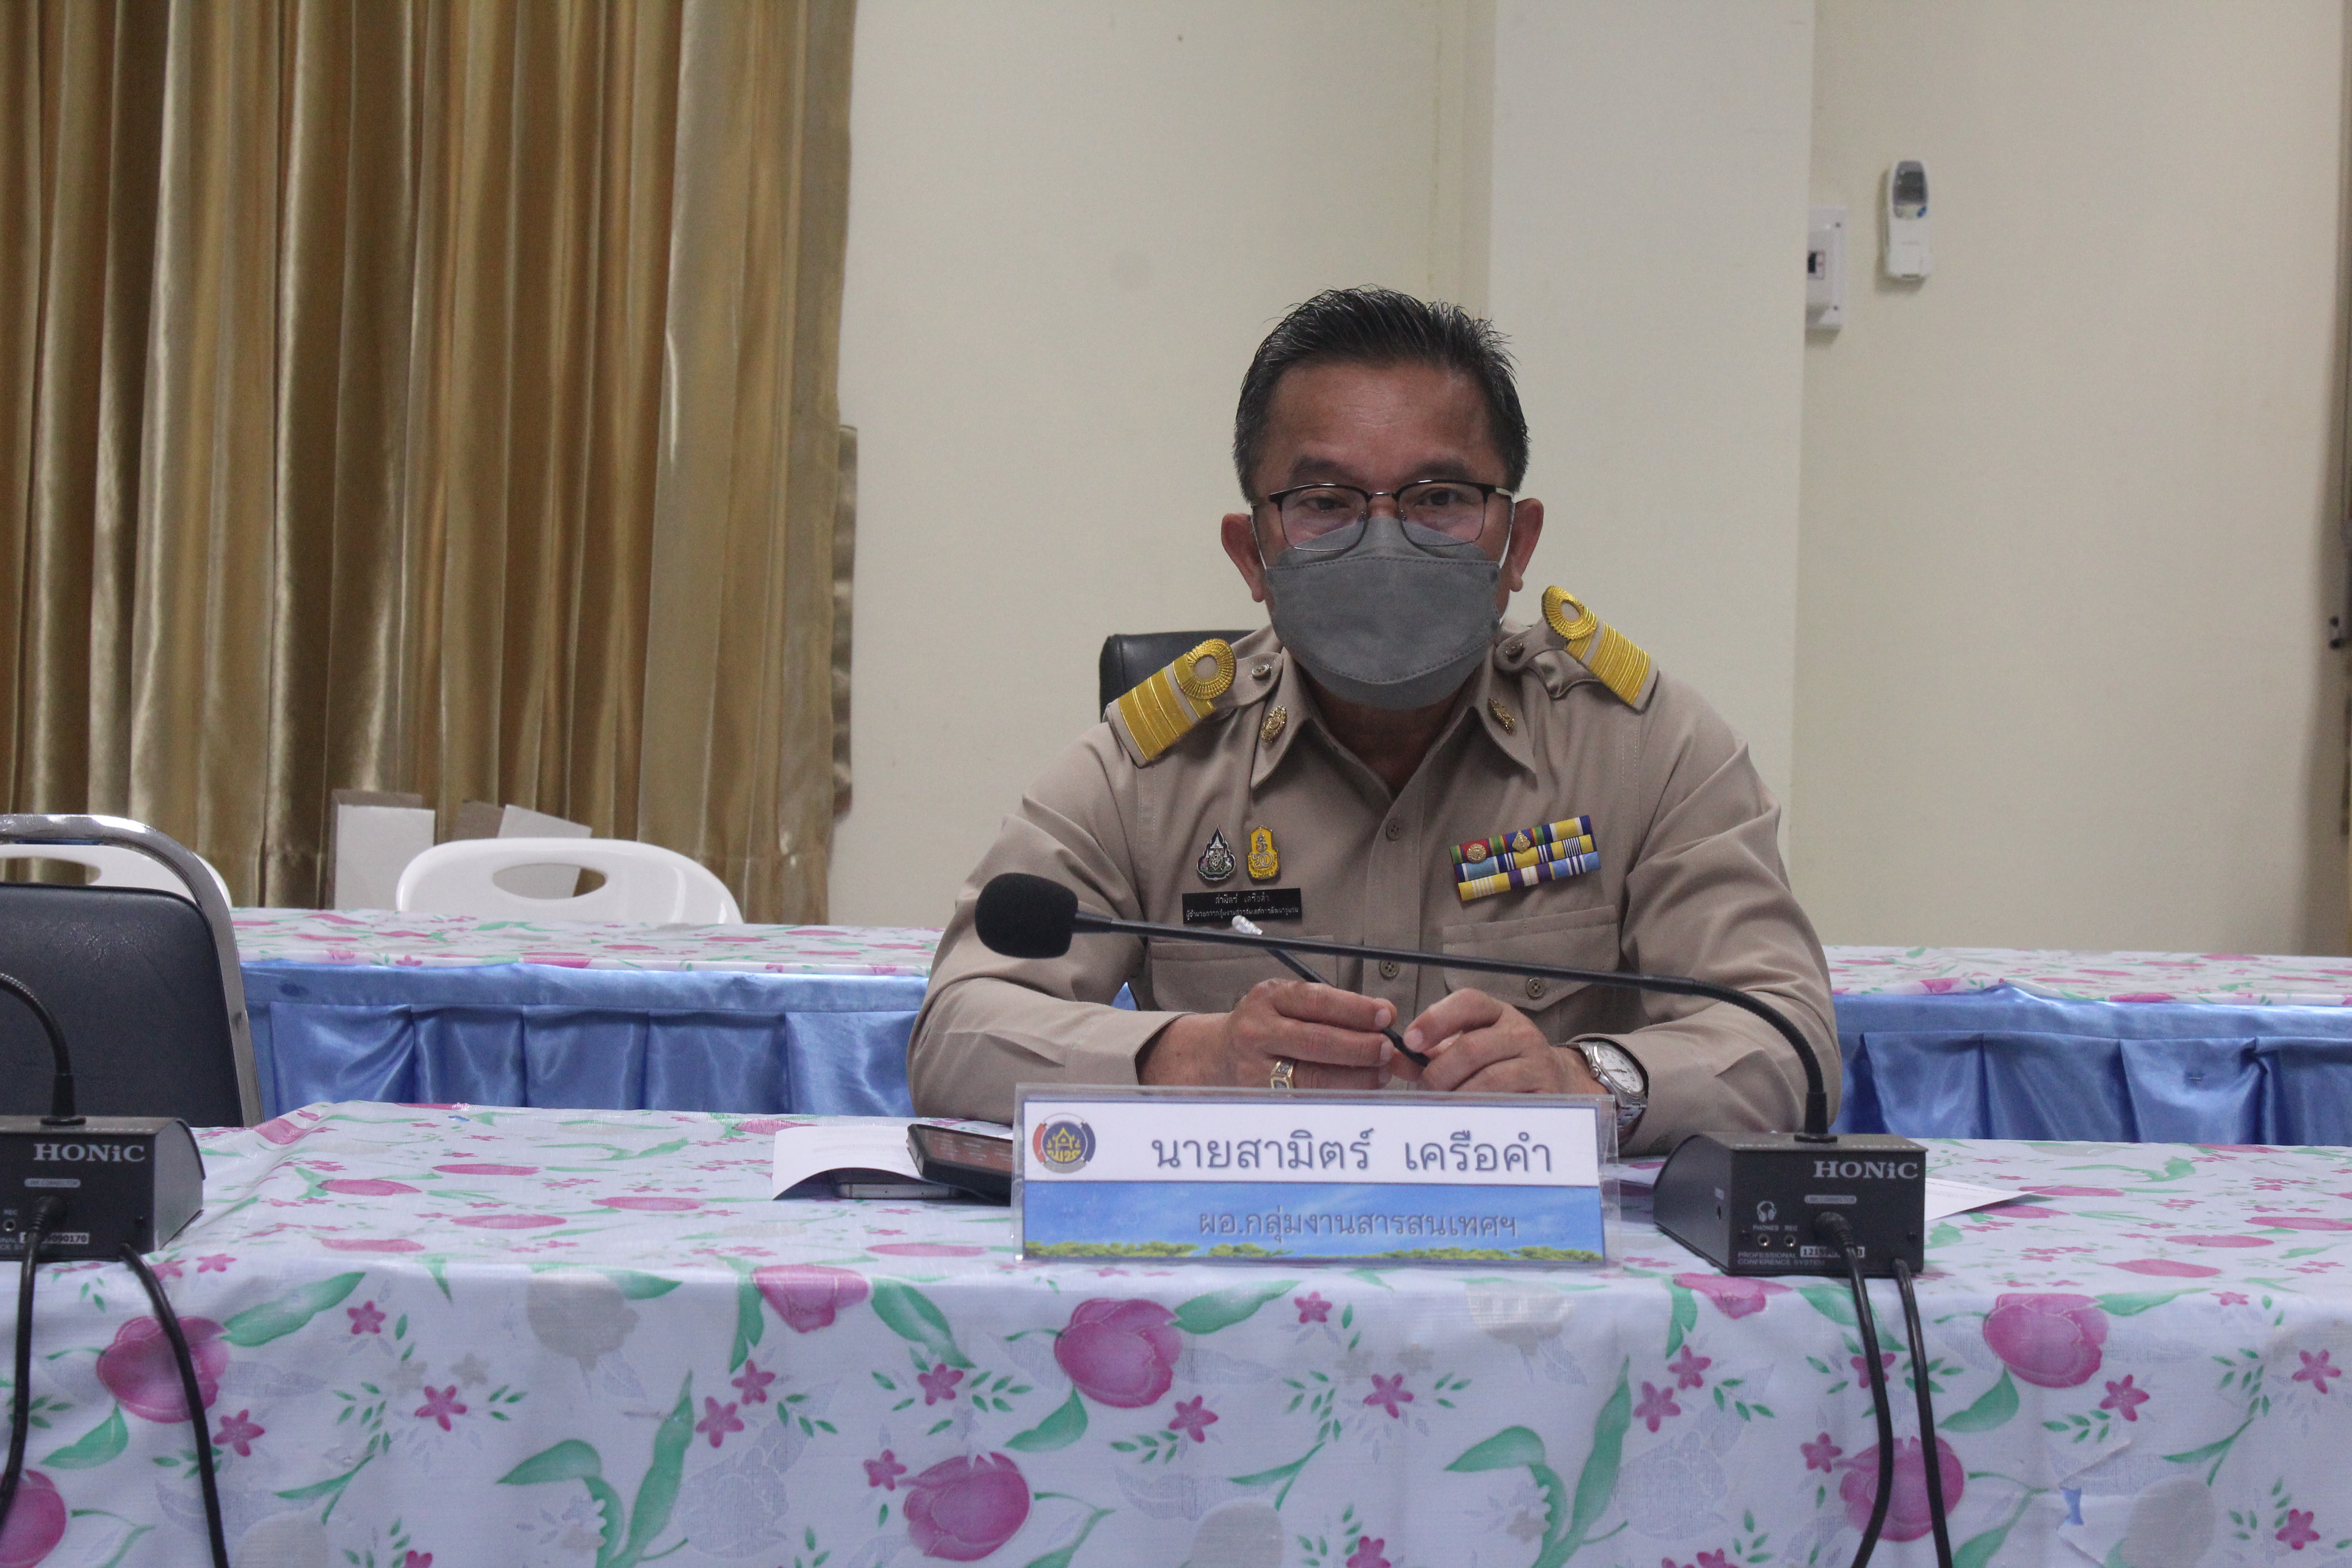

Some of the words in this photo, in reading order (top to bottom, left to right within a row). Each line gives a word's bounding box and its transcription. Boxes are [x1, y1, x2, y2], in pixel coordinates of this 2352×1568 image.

[1152, 1128, 1374, 1170] นายสามิตร์
[1405, 1130, 1551, 1171] เครือคำ
[1199, 1205, 1518, 1244] ผอ.กลุ่มงานสารสนเทศฯ
